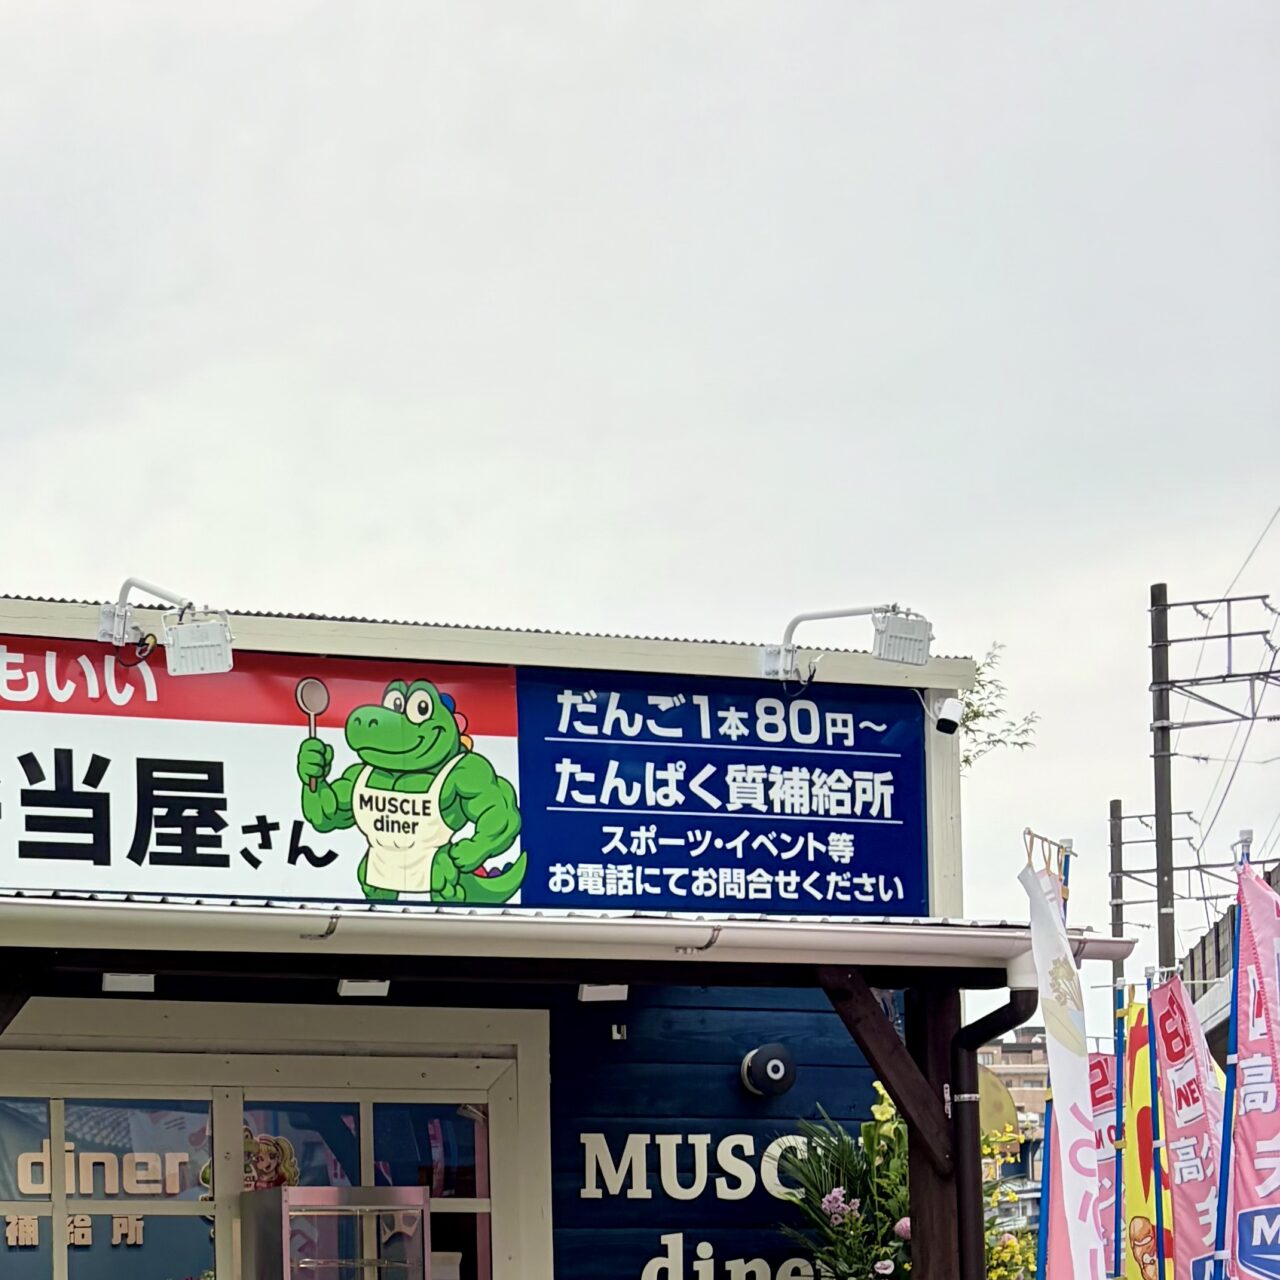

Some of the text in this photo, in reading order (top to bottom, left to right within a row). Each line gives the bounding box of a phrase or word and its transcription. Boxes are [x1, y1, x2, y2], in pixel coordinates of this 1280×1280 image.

[359, 793, 432, 817] MUSCLE
[554, 758, 894, 819] たんぱく質補給所
[373, 815, 419, 834] diner
[601, 824, 855, 864] スポーツ・イベント等
[548, 863, 904, 902] お電話にてお問合せください
[17, 1138, 190, 1195] diner
[580, 1133, 839, 1200] MUSC
